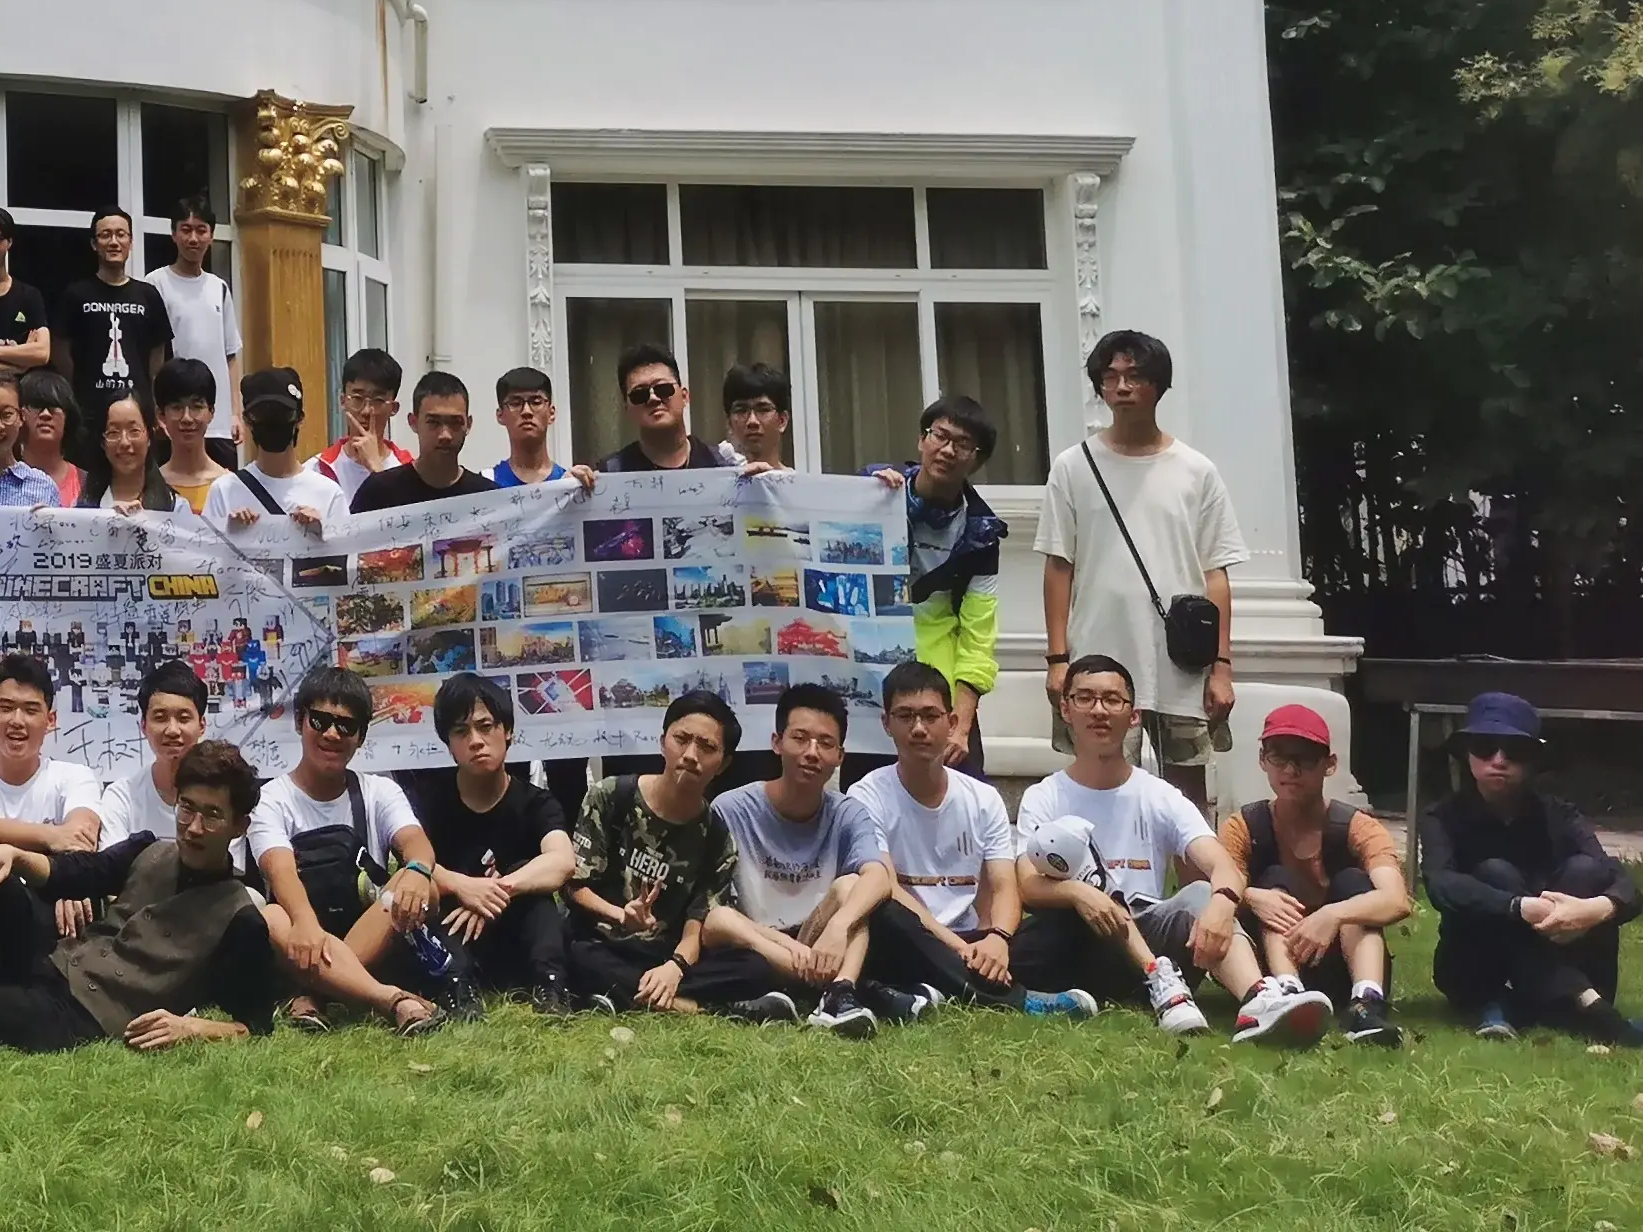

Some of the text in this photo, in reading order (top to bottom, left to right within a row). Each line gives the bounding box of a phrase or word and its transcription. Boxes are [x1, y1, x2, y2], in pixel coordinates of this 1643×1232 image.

[82, 302, 145, 316] DONNAGER
[33, 552, 163, 570] 2019 盛夏派对
[147, 574, 219, 599] CHINA
[629, 847, 671, 882] HERO
